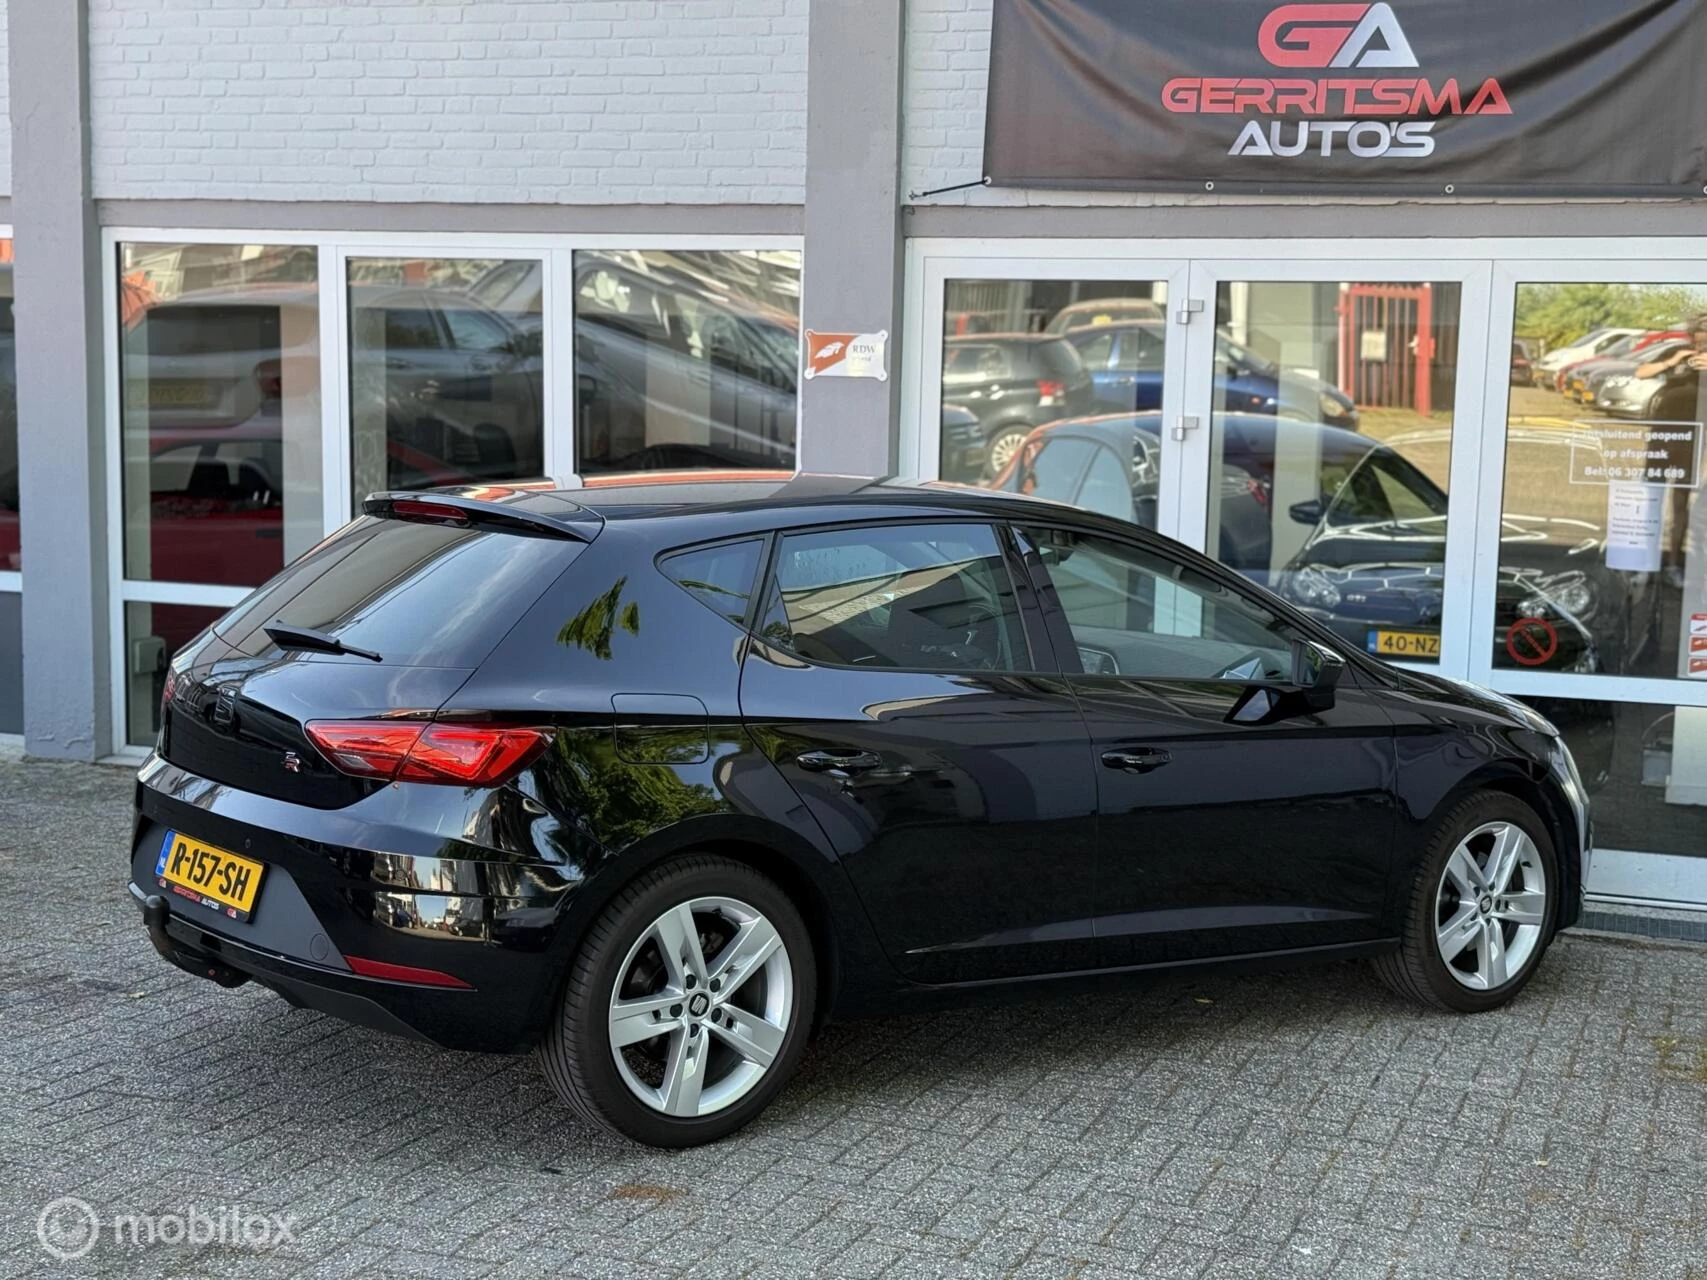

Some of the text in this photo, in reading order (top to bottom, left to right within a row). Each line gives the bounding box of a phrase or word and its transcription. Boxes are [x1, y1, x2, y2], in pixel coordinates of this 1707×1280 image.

[1258, 2, 1419, 68] GA
[1162, 78, 1512, 115] GERRITSMA
[1227, 120, 1436, 158] AUTO'S
[1645, 431, 1692, 442] geopend
[1604, 449, 1668, 459] op afspraak
[1608, 467, 1622, 477] 06
[1626, 467, 1644, 478] 307
[1647, 468, 1662, 478] 84
[1664, 469, 1685, 479] 689
[1384, 634, 1437, 653] 40-NZ
[170, 842, 251, 901] R-157-SH
